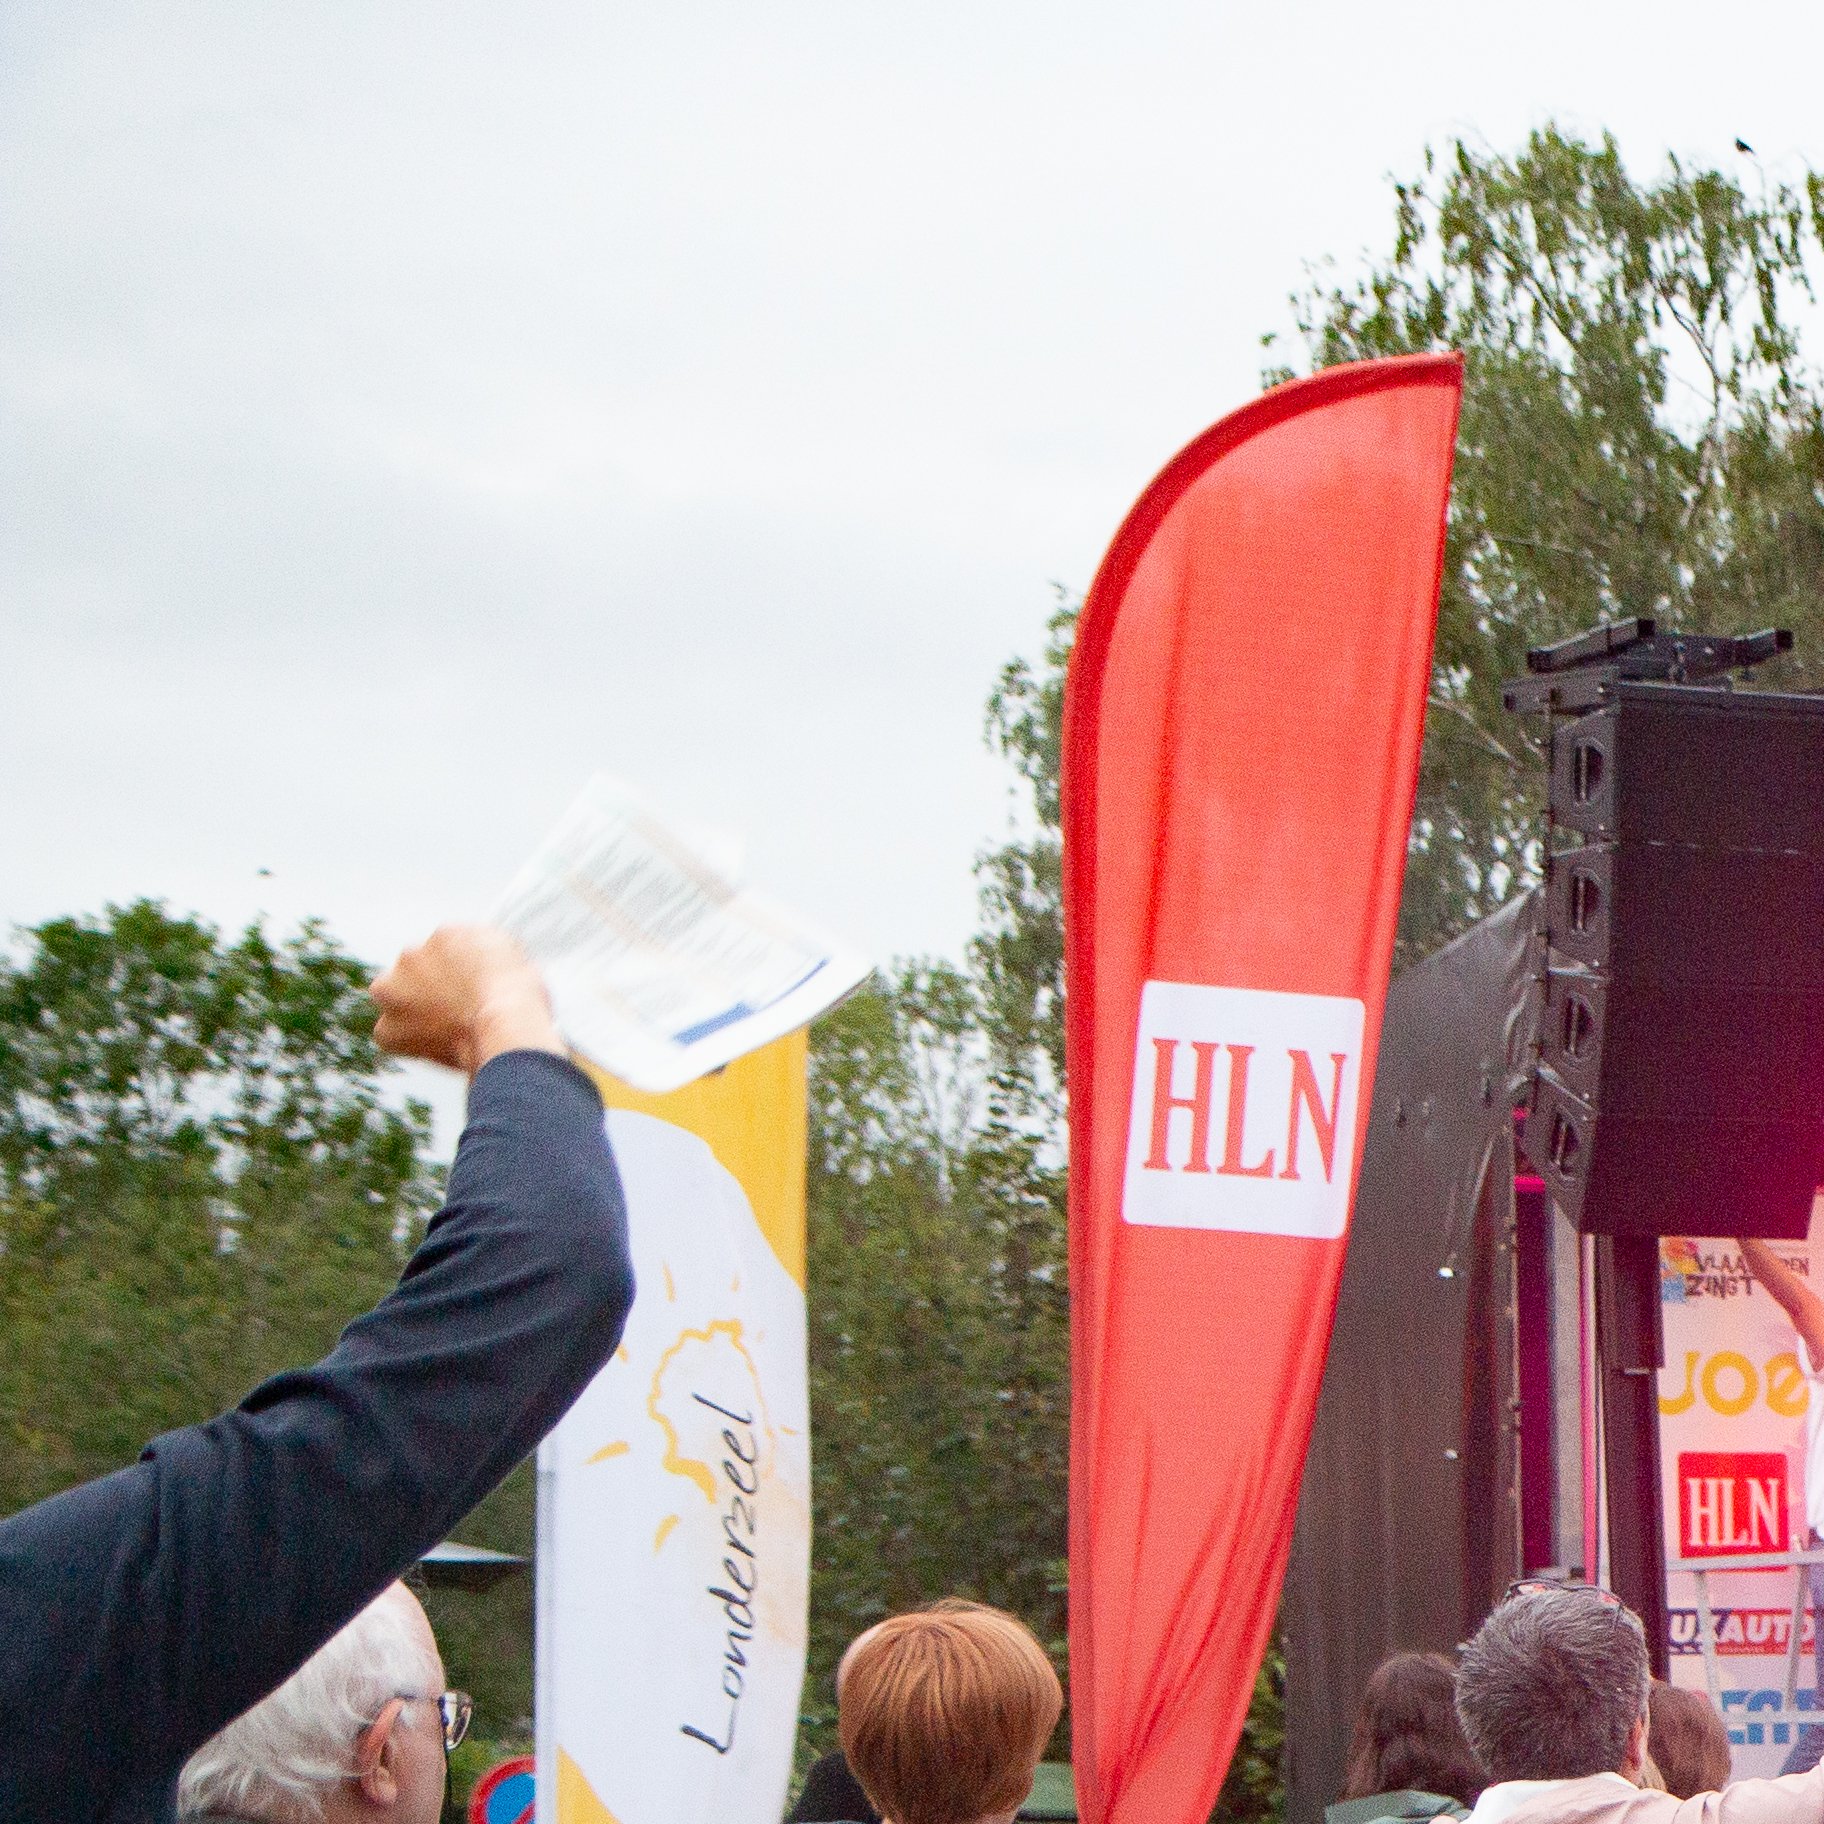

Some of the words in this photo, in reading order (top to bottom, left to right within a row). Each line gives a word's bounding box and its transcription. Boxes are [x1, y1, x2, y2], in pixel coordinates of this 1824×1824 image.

[1142, 1037, 1347, 1184] HLN
[1685, 1273, 1757, 1300] ZINGT
[1686, 1477, 1780, 1547] HLN
[679, 1391, 759, 1755] Londerzeel
